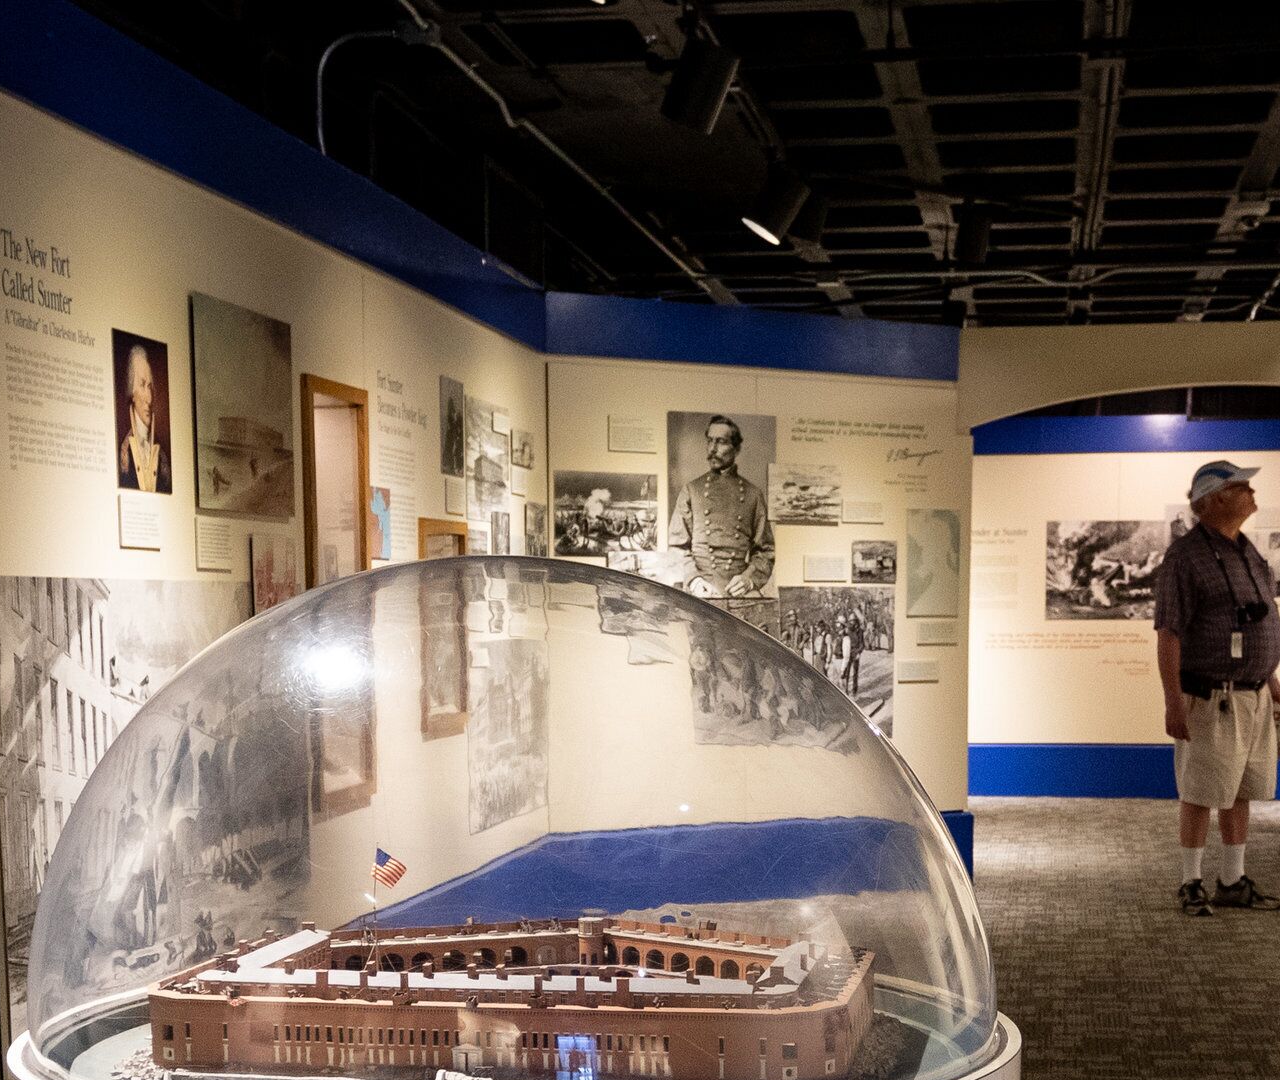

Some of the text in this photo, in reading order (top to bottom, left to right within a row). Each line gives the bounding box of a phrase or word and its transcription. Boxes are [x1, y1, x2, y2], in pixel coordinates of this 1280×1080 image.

[0, 229, 71, 278] The New Fort
[2, 268, 72, 315] Called Sumter
